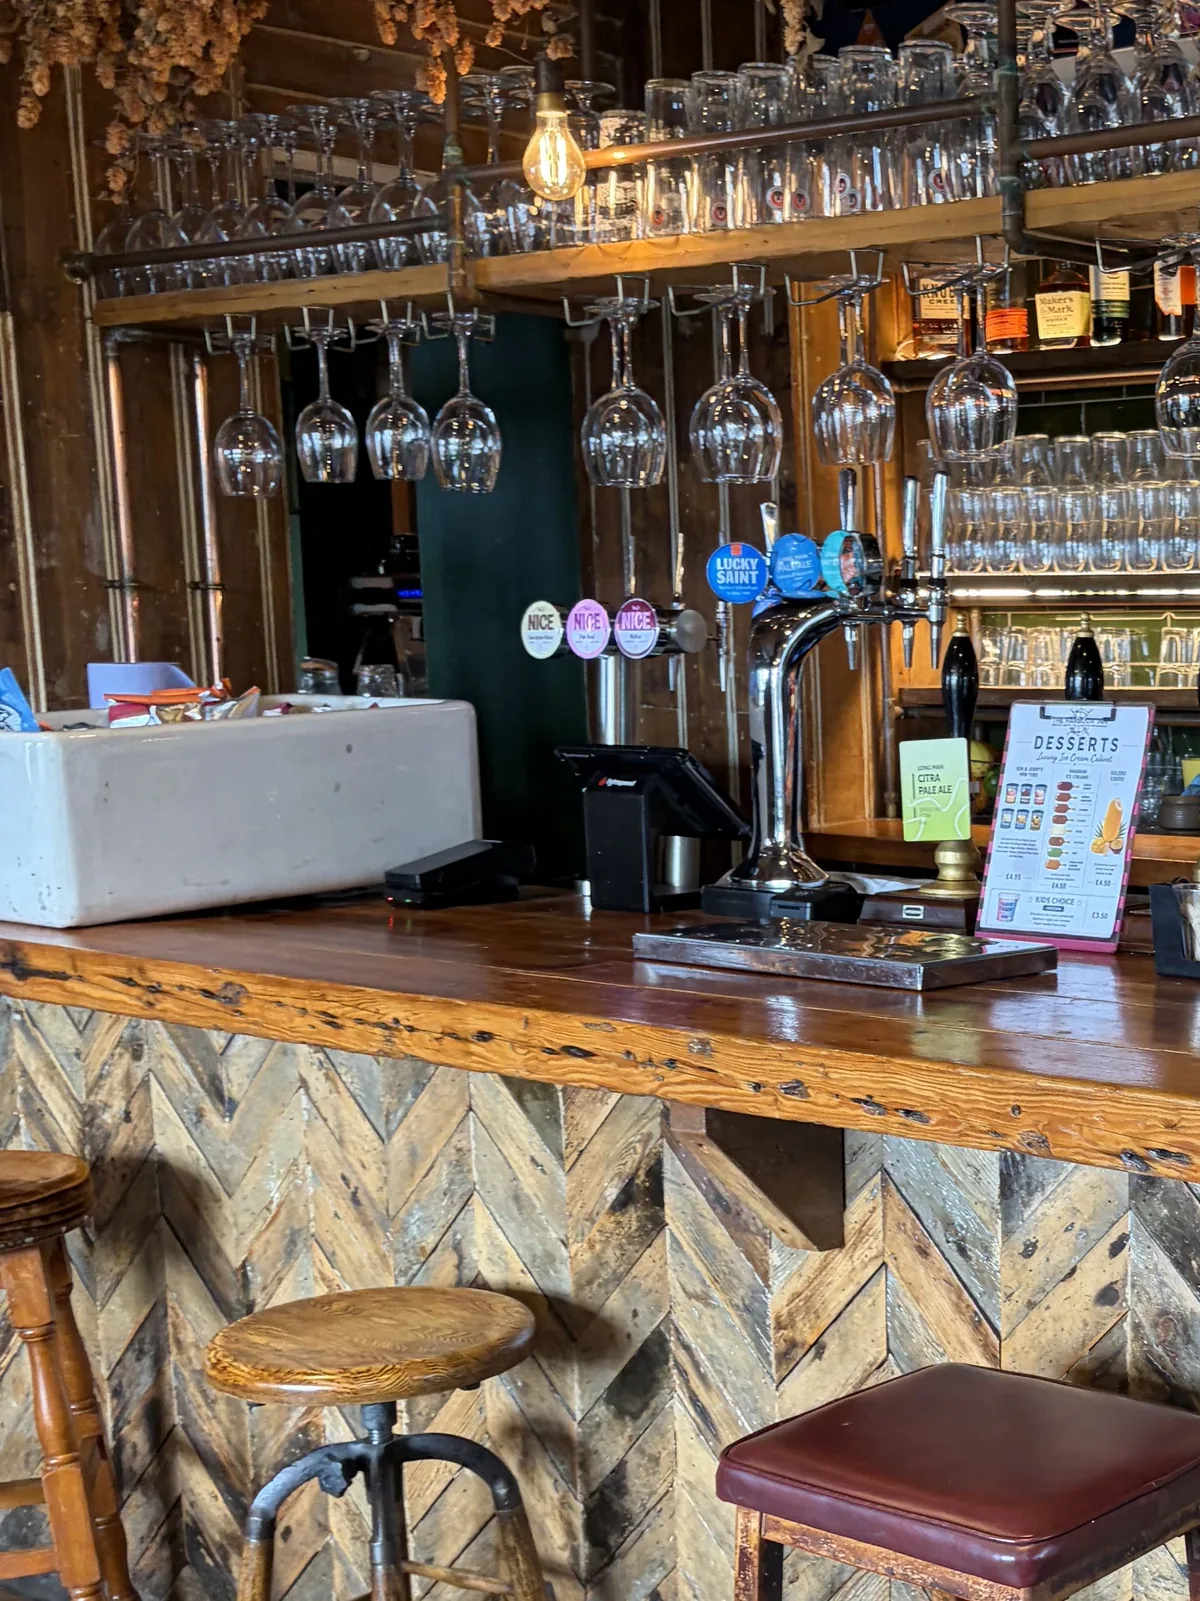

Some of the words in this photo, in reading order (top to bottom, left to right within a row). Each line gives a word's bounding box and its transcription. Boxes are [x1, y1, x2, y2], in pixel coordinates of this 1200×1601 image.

[1040, 296, 1075, 305] Maker's
[1049, 304, 1074, 314] Mark
[716, 557, 759, 570] LUCKY
[716, 571, 759, 584] SAINT
[528, 614, 555, 630] NICE
[574, 613, 601, 631] NICE
[621, 611, 652, 630] NICE
[1034, 735, 1120, 753] DESSERTS
[918, 773, 941, 783] CITRA
[918, 785, 937, 795] PALE
[938, 784, 953, 794] ALE
[1051, 897, 1075, 906] CHOICE
[1091, 911, 1108, 920] £3.50
